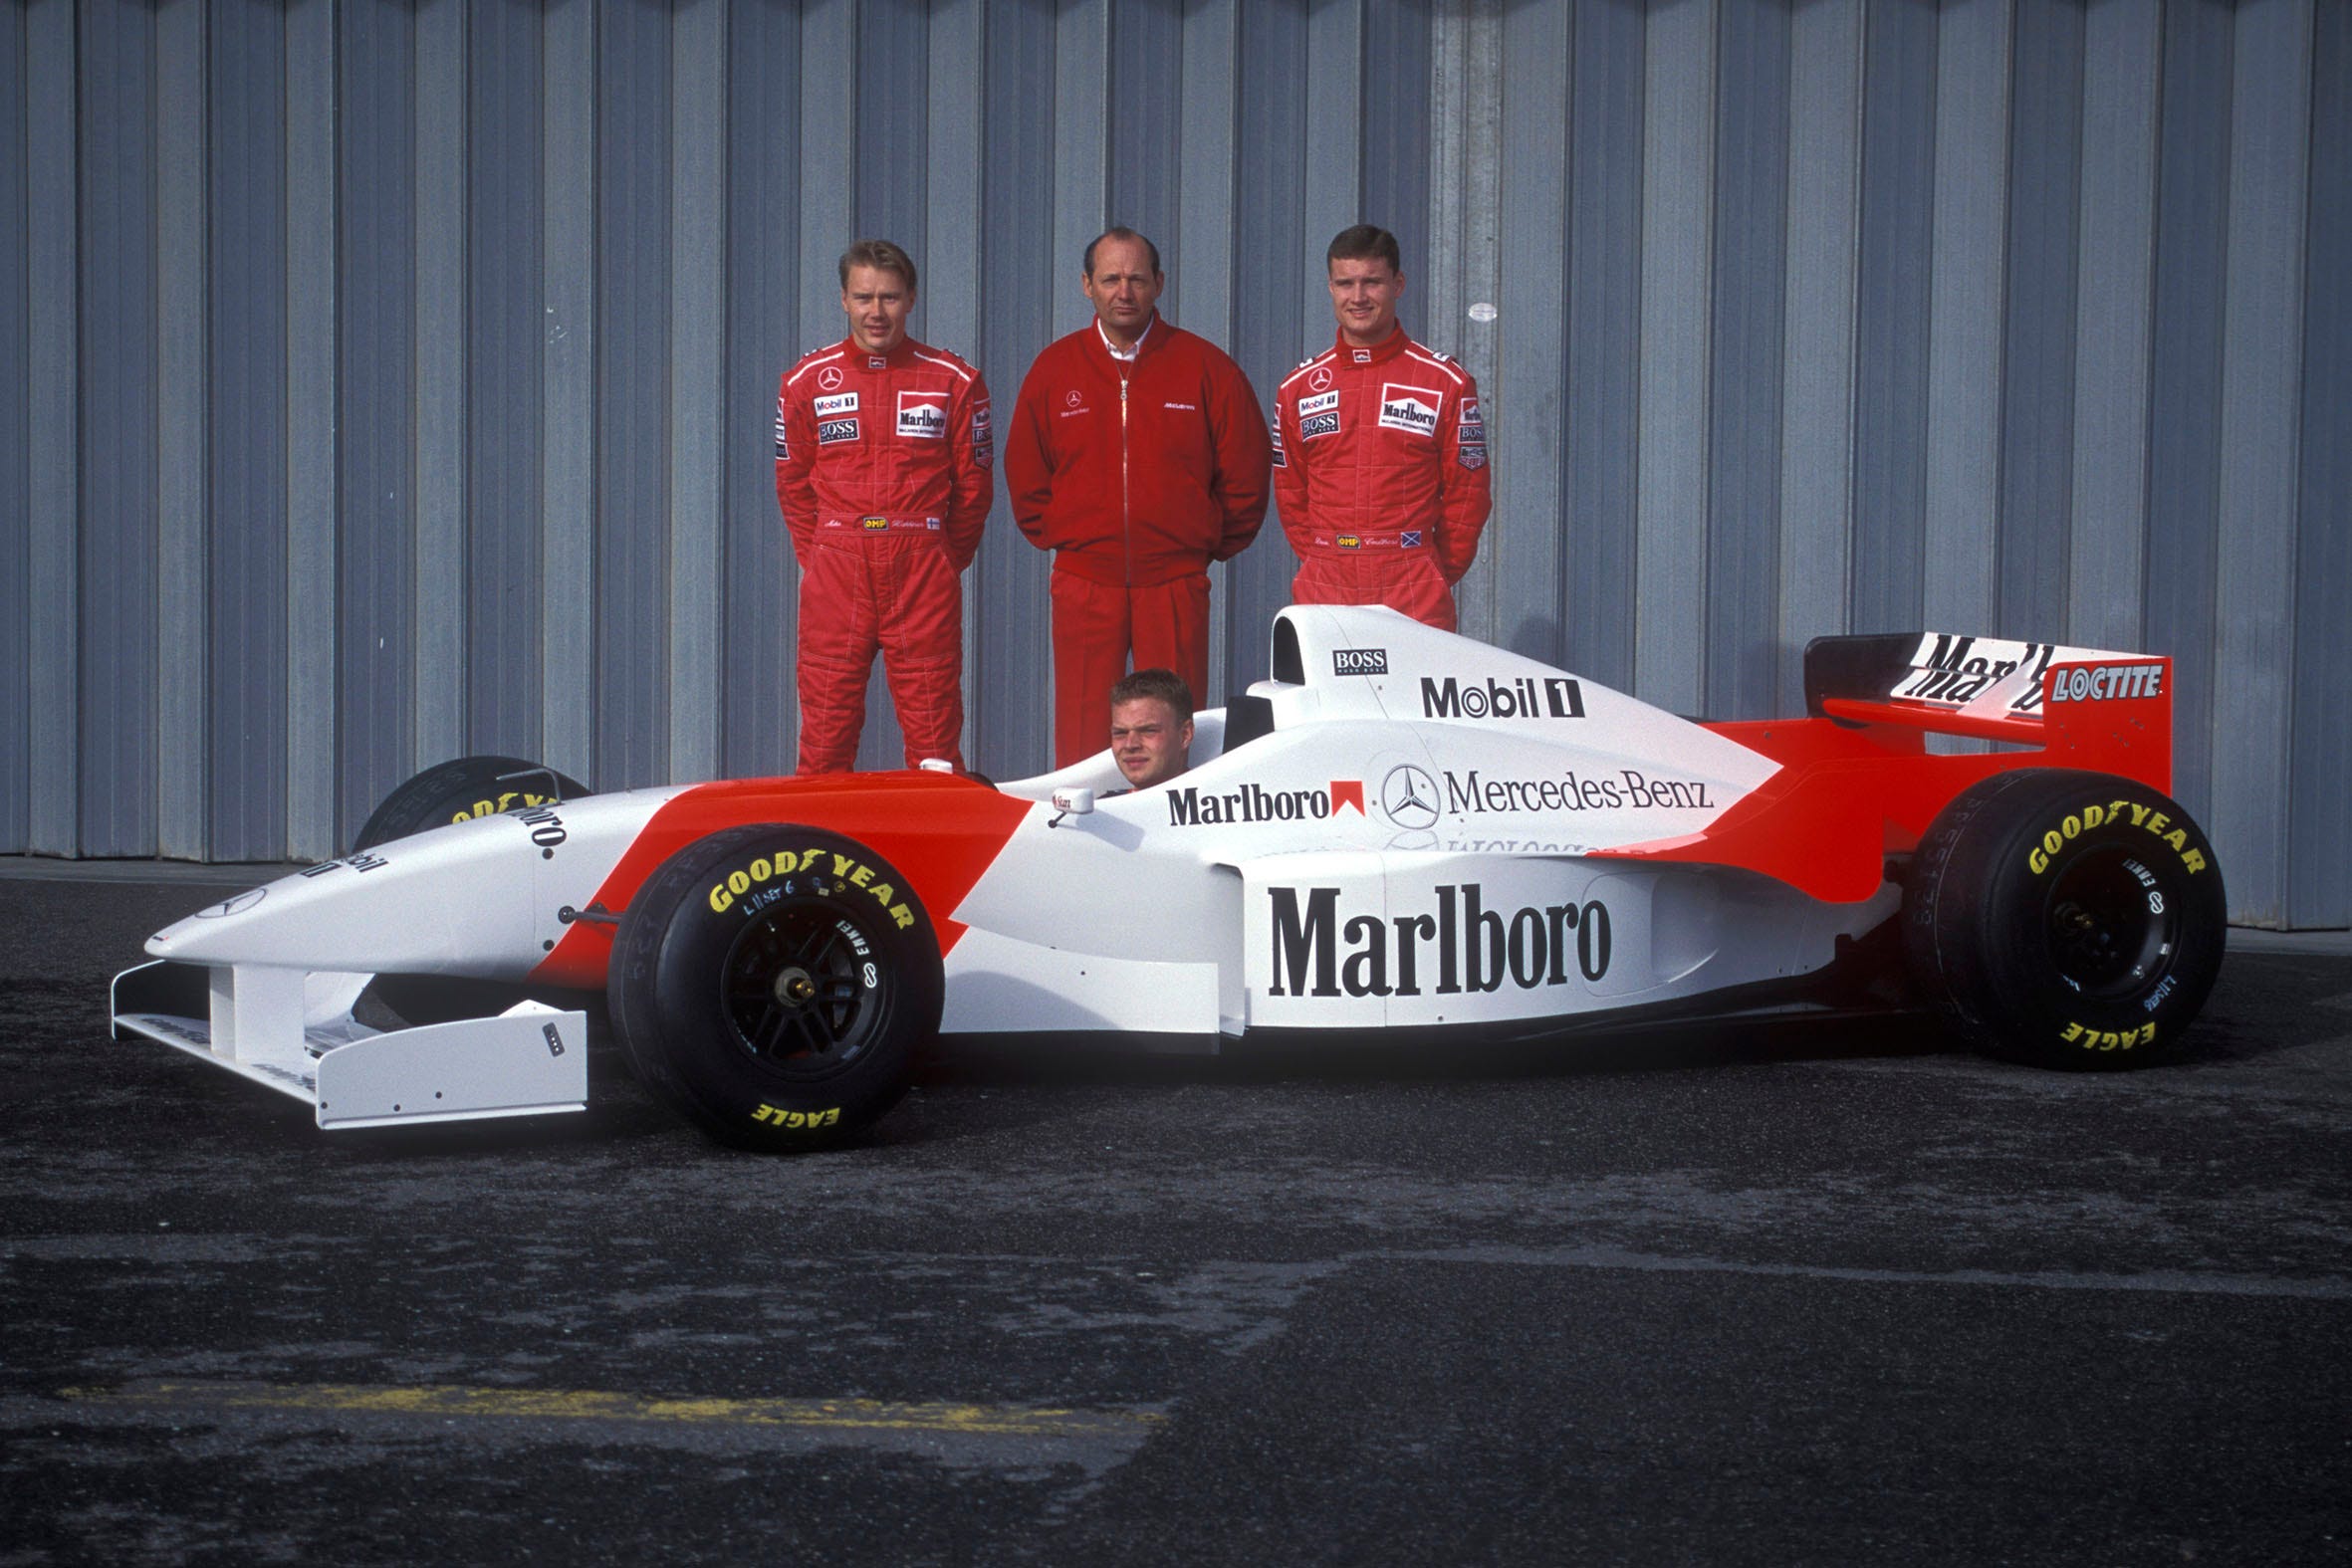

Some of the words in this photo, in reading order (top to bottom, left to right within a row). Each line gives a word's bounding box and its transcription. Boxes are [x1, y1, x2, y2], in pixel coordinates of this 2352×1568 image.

[817, 398, 842, 410] Mobil
[1300, 397, 1324, 412] Mobil
[1382, 402, 1436, 425] Marlboro
[821, 421, 855, 437] BOSS
[1302, 414, 1335, 433] BOSS
[865, 520, 885, 529] OMP
[1338, 537, 1358, 547] OMP
[1335, 650, 1385, 668] BOSS
[2051, 664, 2165, 702] LOCTITE
[1420, 677, 1539, 719] Mobil
[1550, 680, 1576, 717] 1
[1443, 770, 1715, 814] Mercedes-Benz
[1166, 783, 1330, 827] Marlboro
[1268, 883, 1612, 998] Marlboro
[2060, 1021, 2156, 1051] EAGLE
[751, 1103, 840, 1129] EAGLE
